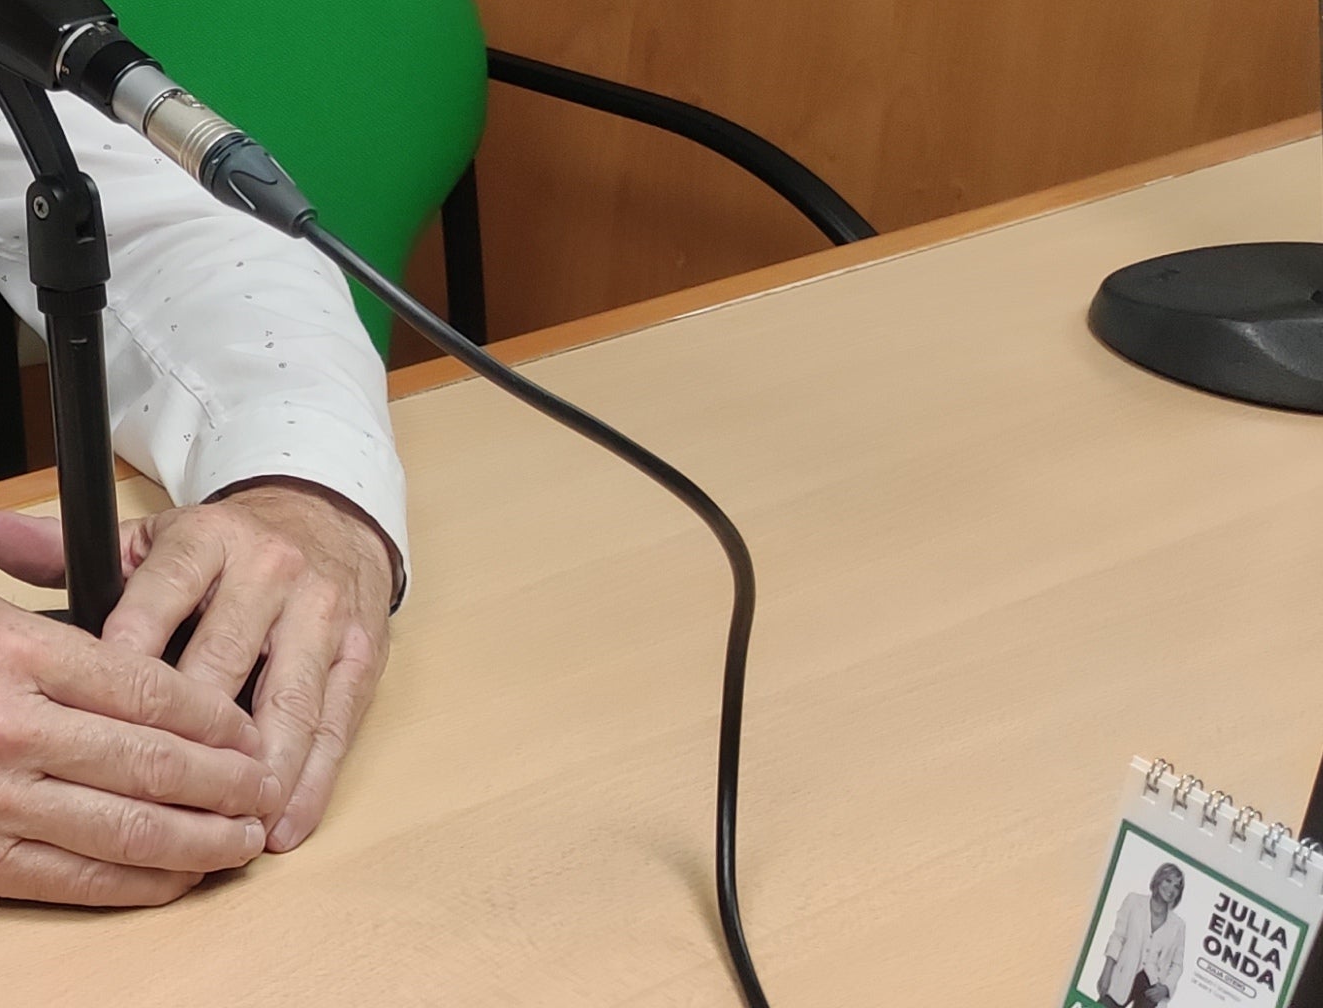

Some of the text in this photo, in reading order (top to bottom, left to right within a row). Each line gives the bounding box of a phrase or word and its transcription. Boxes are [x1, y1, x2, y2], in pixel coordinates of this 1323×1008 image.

[1208, 913, 1281, 971] EN LA
[1214, 892, 1287, 949] JULIA
[1203, 935, 1275, 993] ONDA
